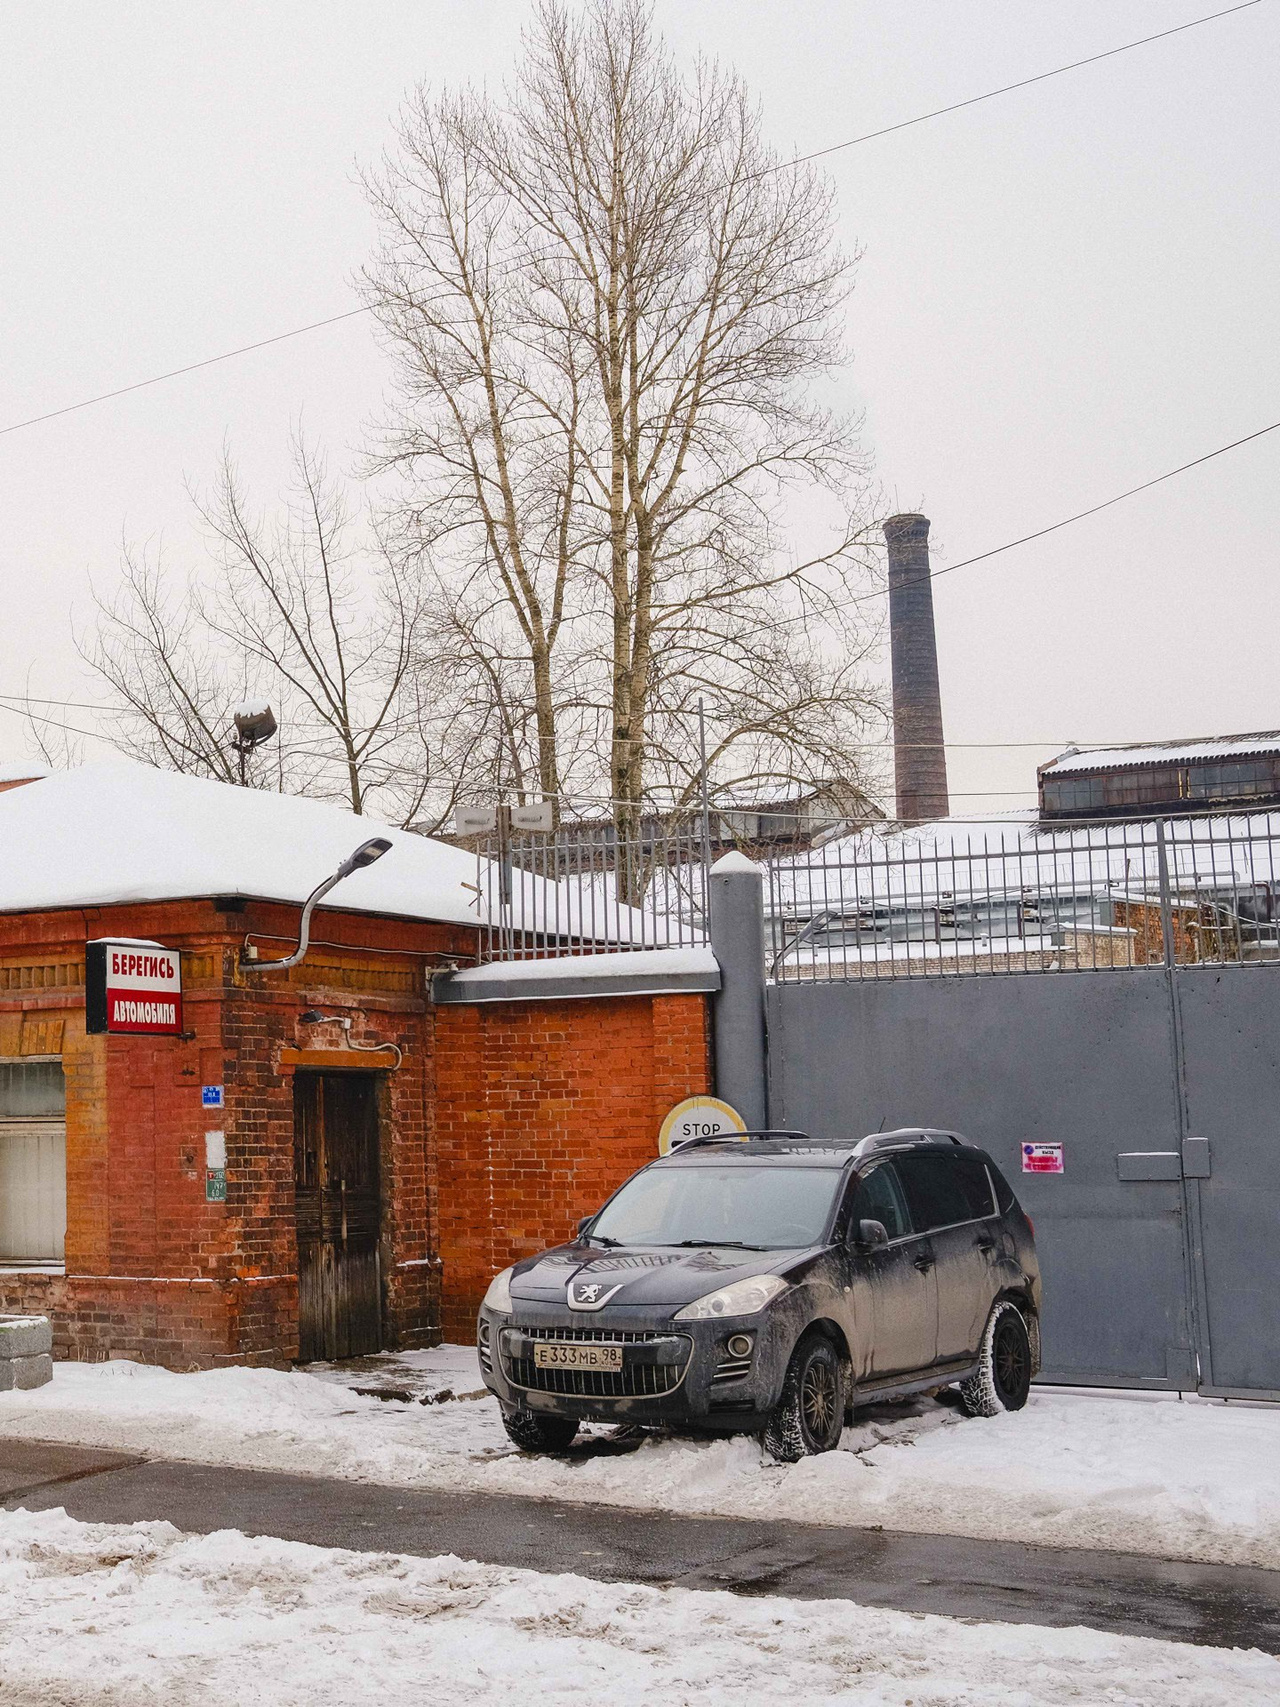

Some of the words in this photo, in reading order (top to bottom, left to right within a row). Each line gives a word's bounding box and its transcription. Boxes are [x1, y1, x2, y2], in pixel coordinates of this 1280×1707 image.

[112, 953, 174, 979] БЕРЕГИСЬ
[113, 1000, 176, 1025] АВТОМОБИЛЯ
[682, 1123, 721, 1136] STOP
[602, 1348, 617, 1361] 98
